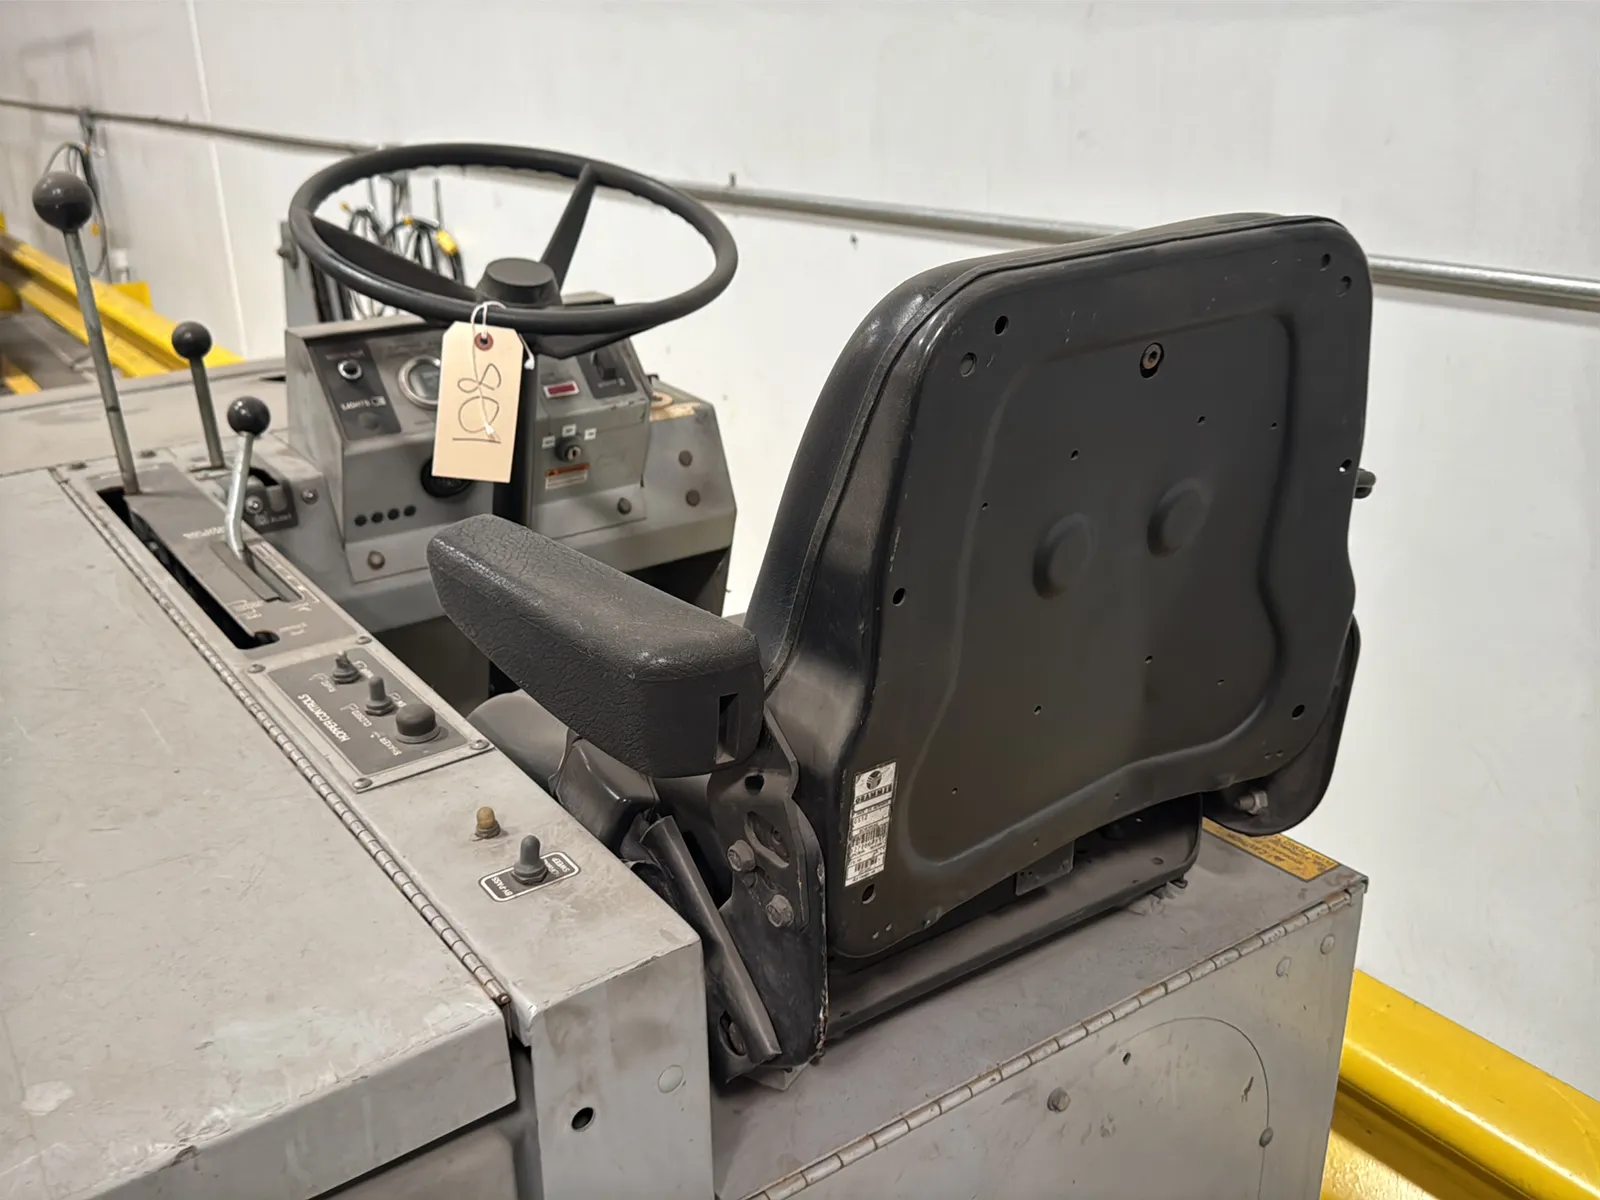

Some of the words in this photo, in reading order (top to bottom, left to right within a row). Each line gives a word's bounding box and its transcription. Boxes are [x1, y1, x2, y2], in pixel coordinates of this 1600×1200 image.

[297, 693, 331, 722] CONTROLS
[323, 717, 351, 742] HOPPER
[491, 876, 514, 896] BY-PASS
